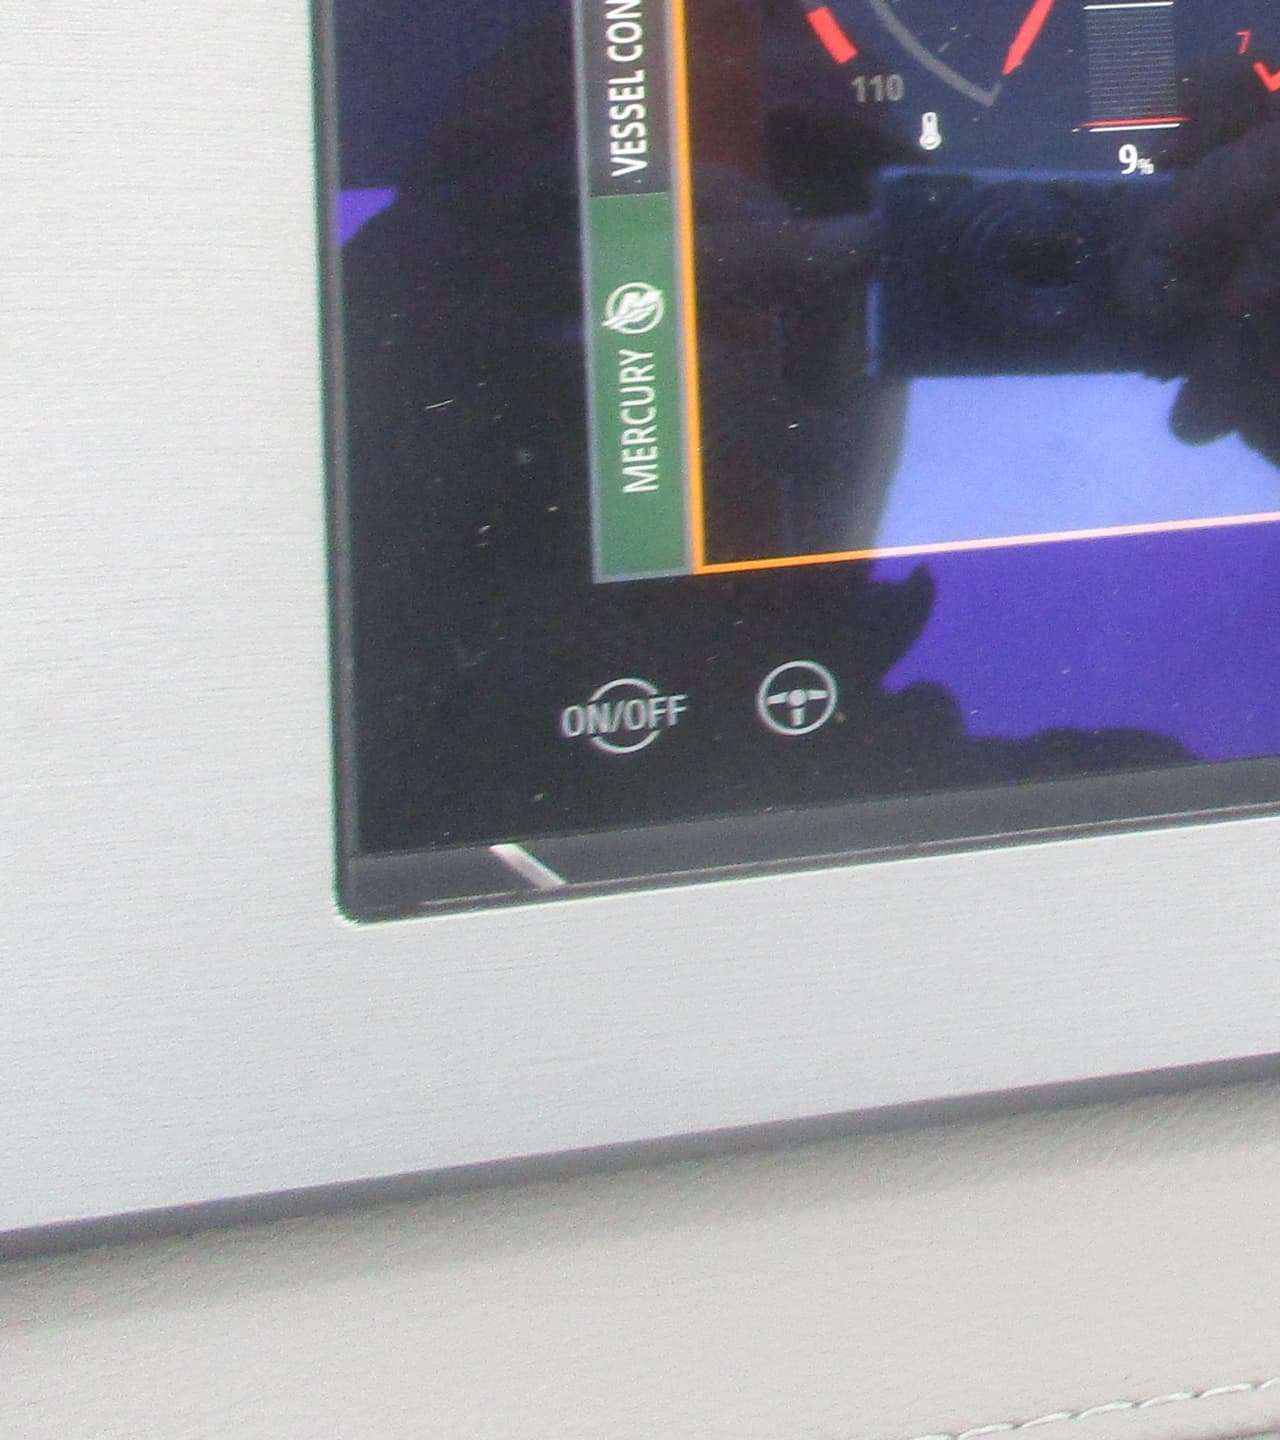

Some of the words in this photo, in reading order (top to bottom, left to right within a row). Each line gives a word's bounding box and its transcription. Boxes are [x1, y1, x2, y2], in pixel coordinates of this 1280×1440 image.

[1237, 30, 1251, 54] 7
[851, 73, 904, 103] 110
[610, 69, 648, 178] VESSEL
[620, 348, 660, 495] MERCURY
[561, 693, 688, 738] ON/OFF
